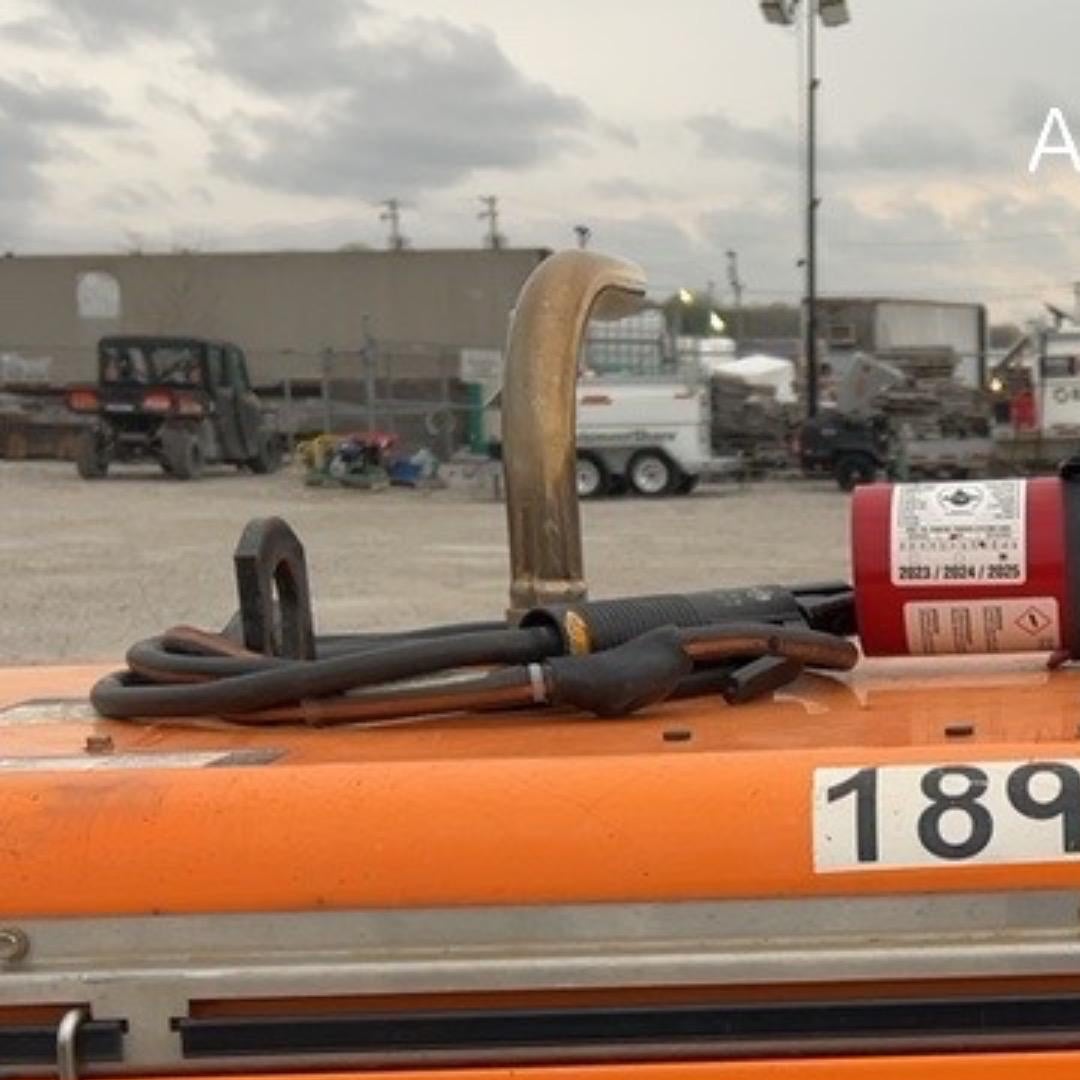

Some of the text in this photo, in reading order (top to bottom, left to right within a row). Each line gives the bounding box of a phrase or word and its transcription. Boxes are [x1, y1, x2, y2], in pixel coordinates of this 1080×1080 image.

[898, 565, 931, 580] 2023
[942, 564, 975, 580] 2024
[987, 563, 1021, 579] 2025
